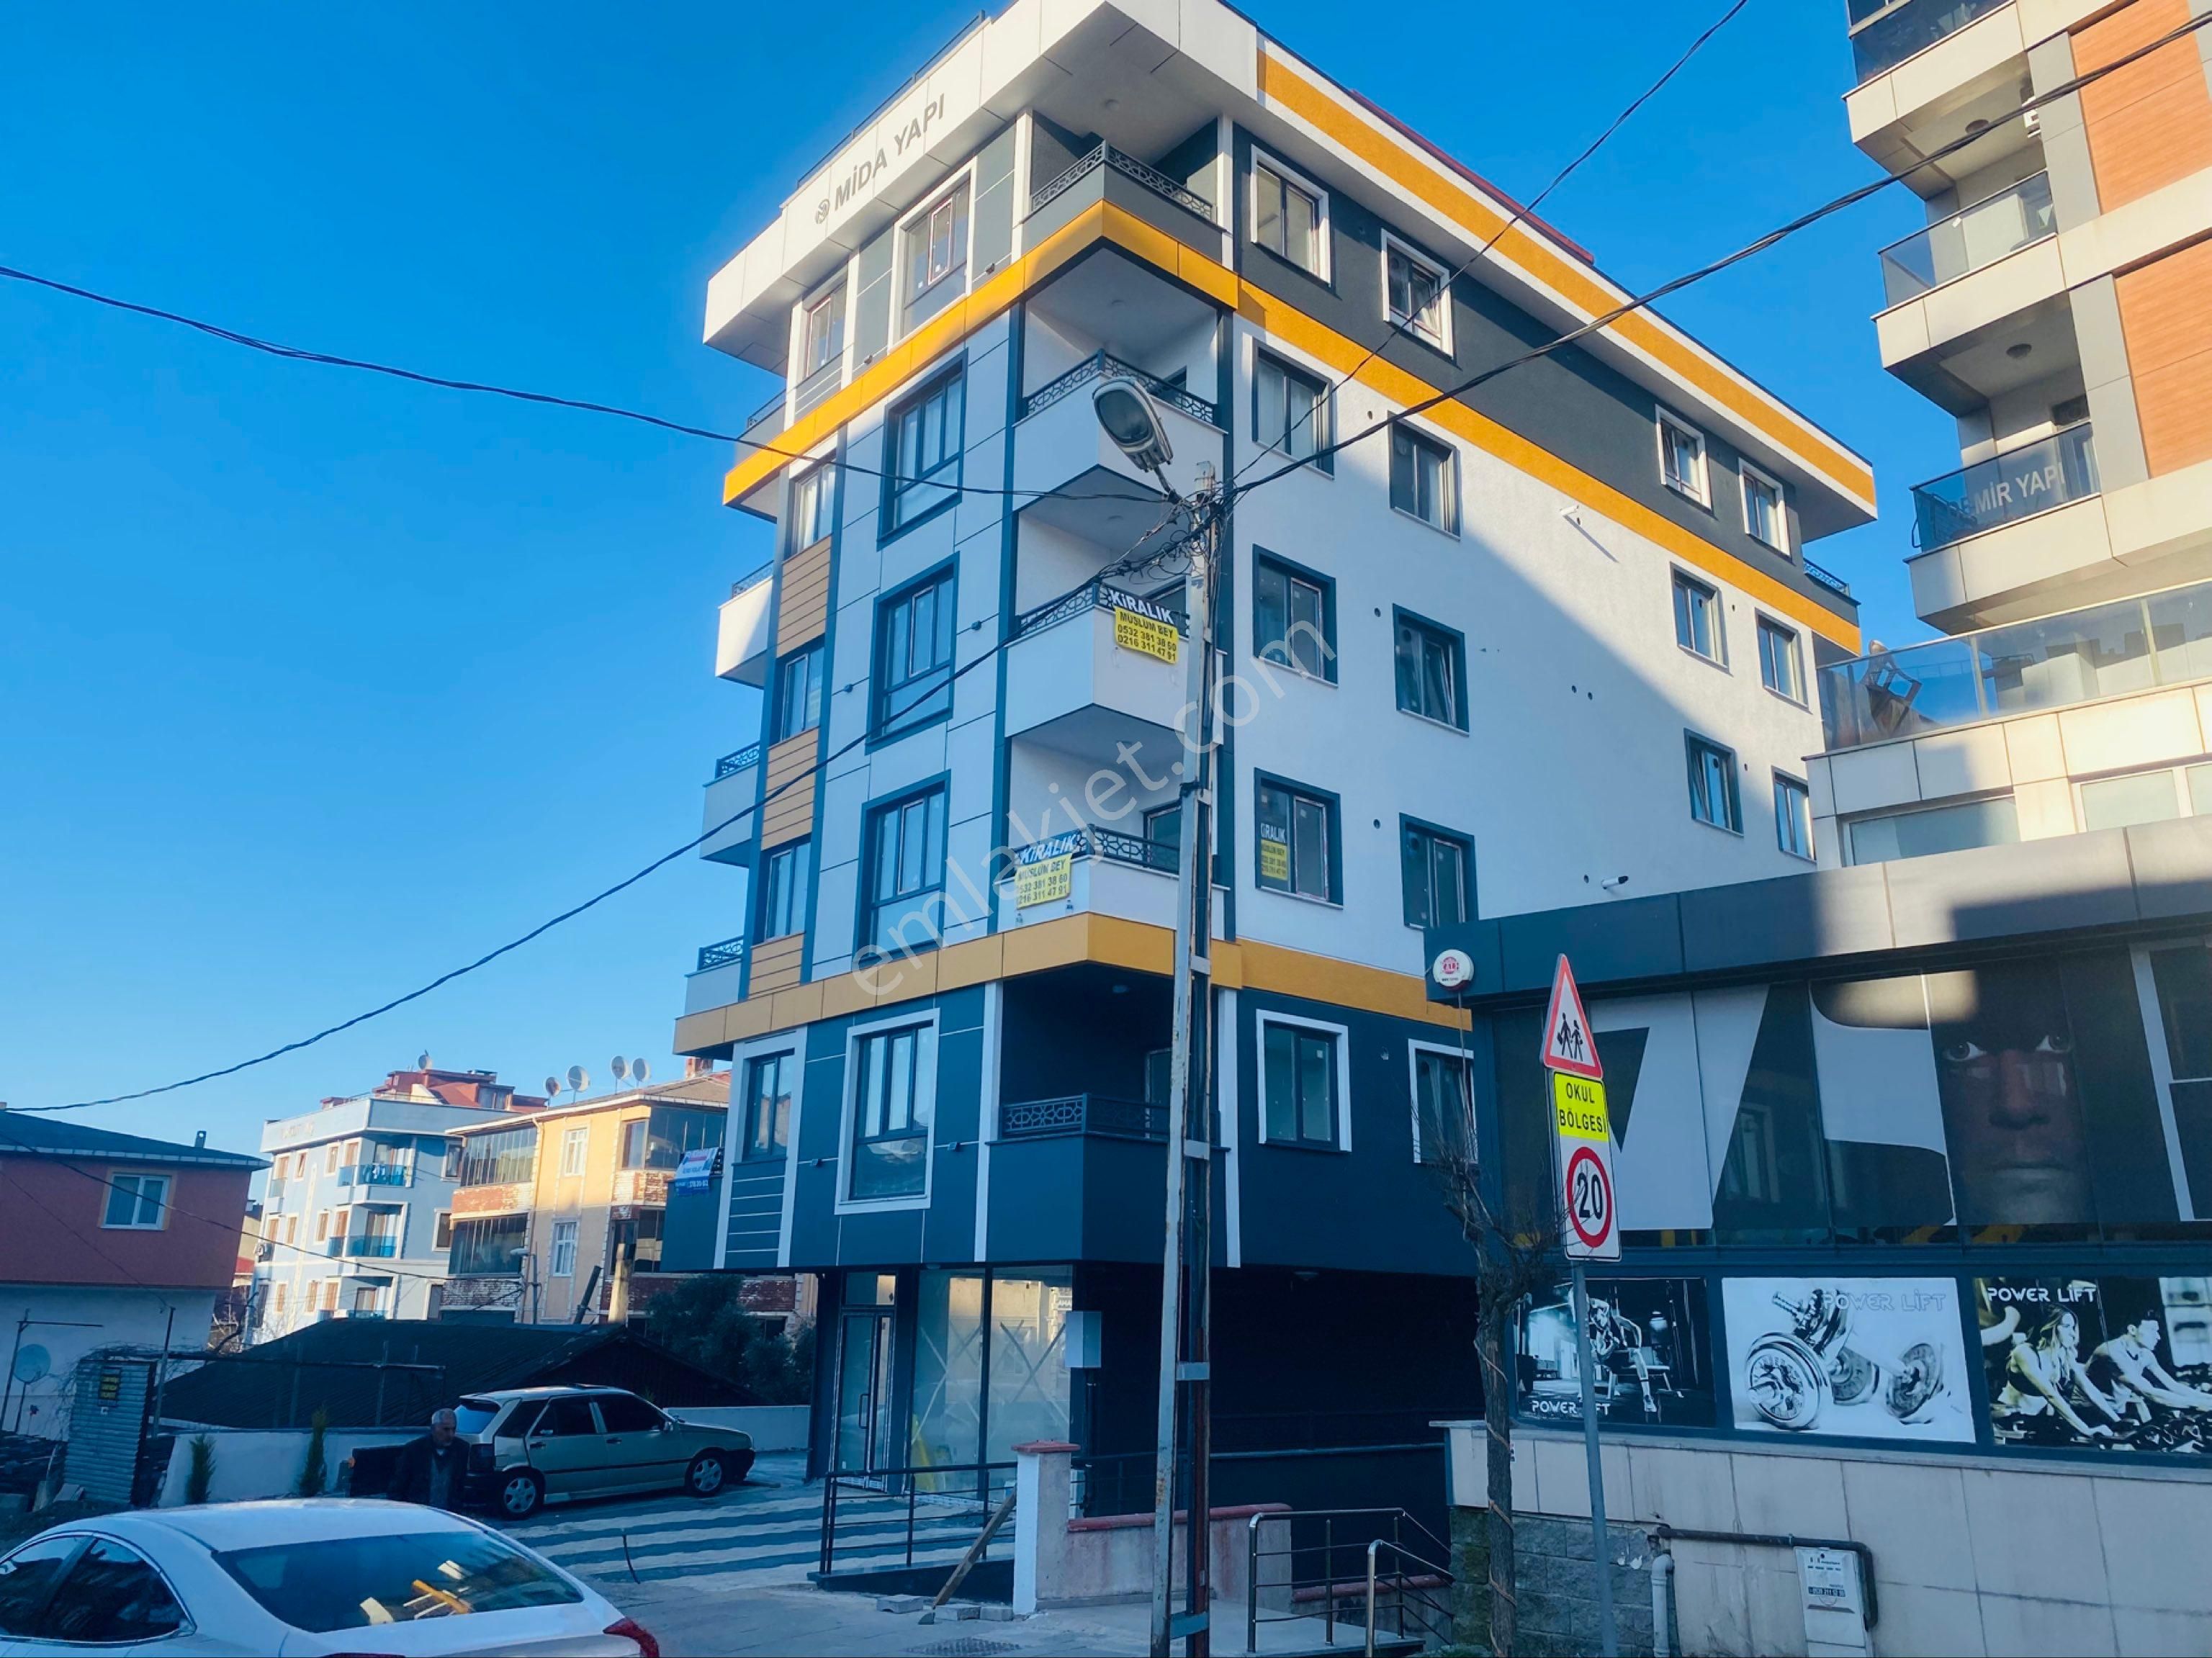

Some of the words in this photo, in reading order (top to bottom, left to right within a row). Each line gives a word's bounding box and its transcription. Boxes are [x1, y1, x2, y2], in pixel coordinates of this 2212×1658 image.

[835, 147, 887, 211] MİDA
[894, 93, 945, 156] YAPI
[2015, 462, 2065, 497] YAPI
[1118, 624, 1138, 637] 0532
[1118, 634, 1139, 647] 0216
[1141, 641, 1156, 652] 311
[1566, 1082, 1596, 1104] OKUL
[1559, 1108, 1607, 1134] BÖLGESİ
[1577, 1172, 1604, 1220] 20
[1987, 1287, 2051, 1302] POWER
[1532, 1400, 1578, 1414] POWER
